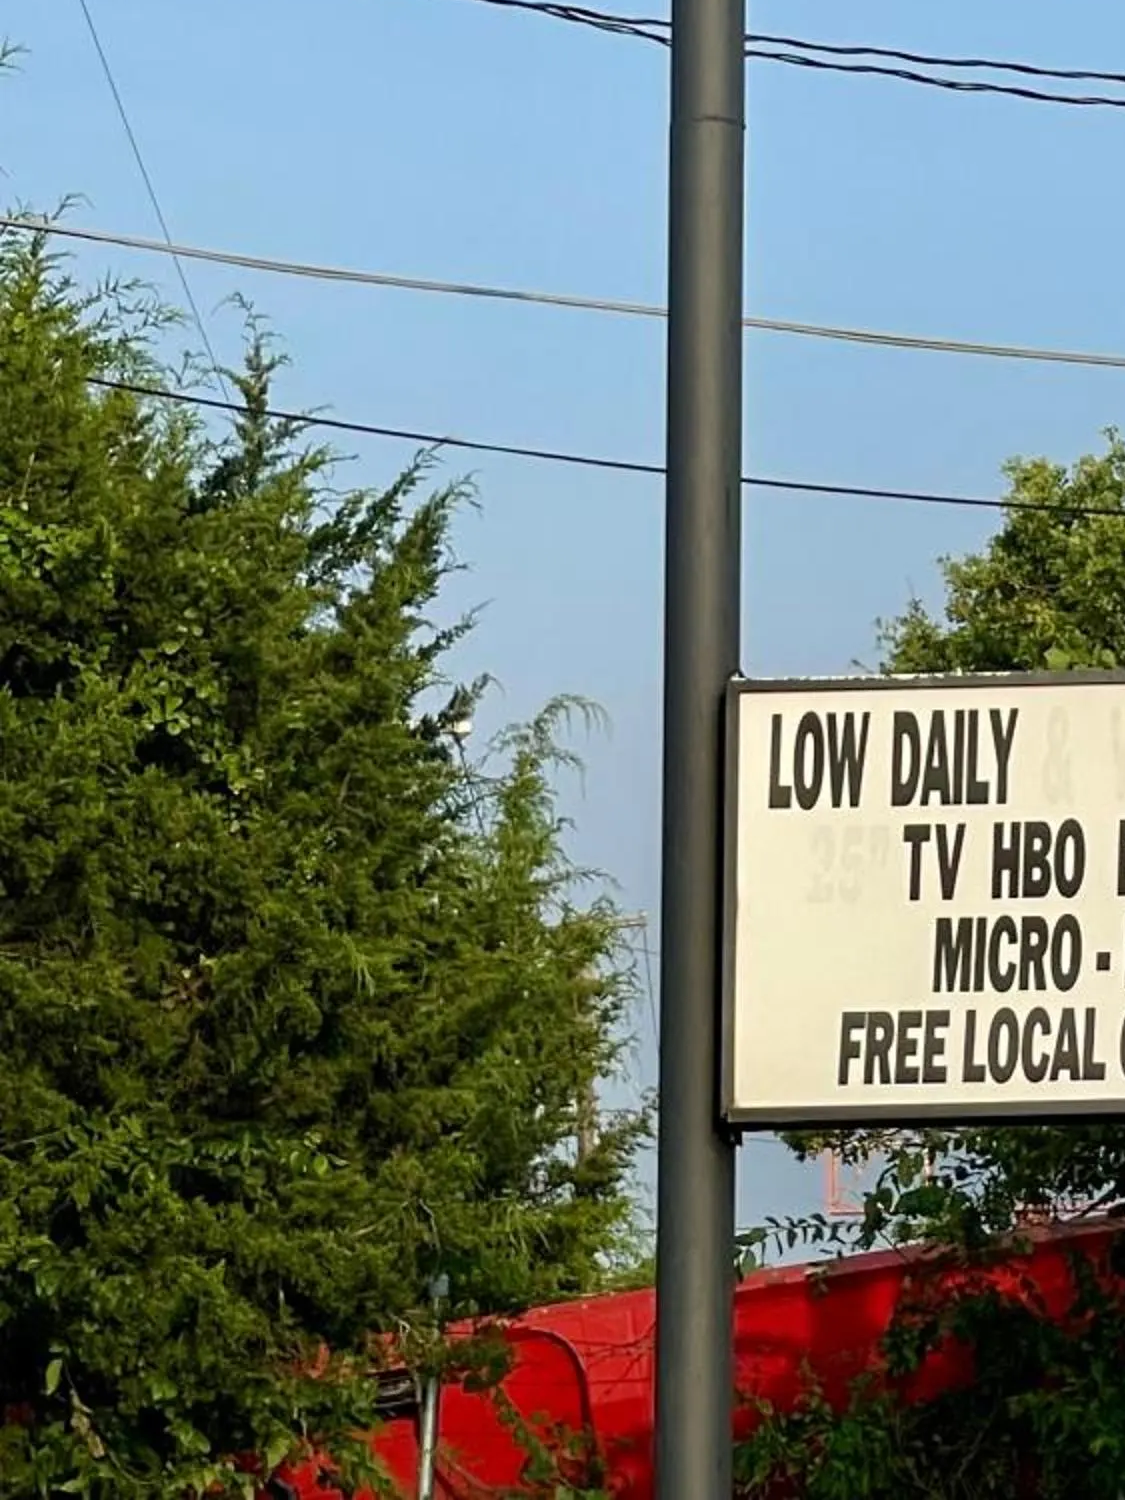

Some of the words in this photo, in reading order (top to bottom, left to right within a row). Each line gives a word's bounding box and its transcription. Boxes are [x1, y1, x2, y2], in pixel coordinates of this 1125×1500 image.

[768, 711, 871, 811] LOW
[890, 707, 1024, 807] DAILY
[903, 823, 967, 901] TV
[990, 818, 1086, 900] HBO
[932, 913, 1083, 993] MICRO
[837, 1009, 951, 1086] FREE
[961, 1006, 1106, 1085] LOCAL
